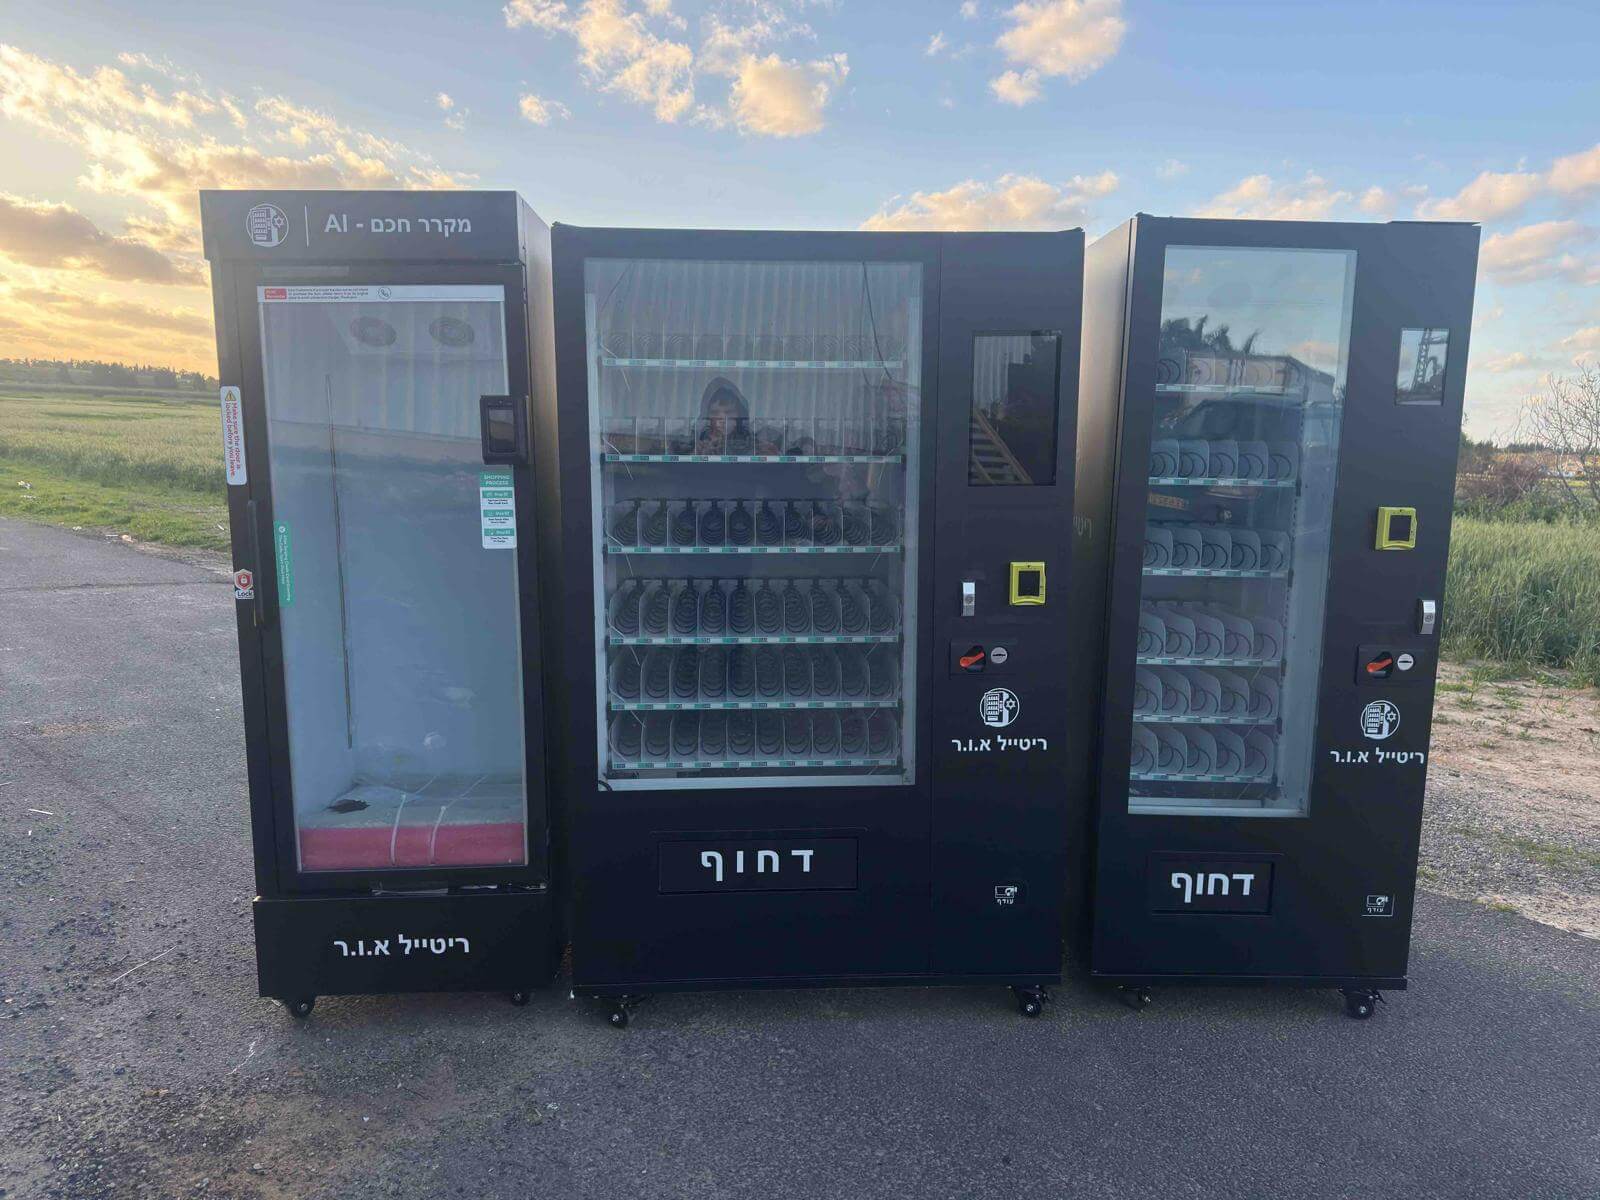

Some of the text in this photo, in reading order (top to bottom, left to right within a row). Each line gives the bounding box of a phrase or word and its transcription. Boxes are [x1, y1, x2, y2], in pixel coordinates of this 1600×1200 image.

[323, 213, 348, 233] AI
[370, 217, 411, 233] חכם
[417, 217, 472, 238] מקרר
[227, 446, 235, 459] you
[951, 734, 1048, 752] ריטייל א.ו.ר
[1330, 747, 1425, 764] ריטייל א.ו.ר
[1171, 872, 1255, 904] דחוף
[996, 898, 1015, 906] עודף
[333, 933, 470, 957] ריטייל א.ו.ר
